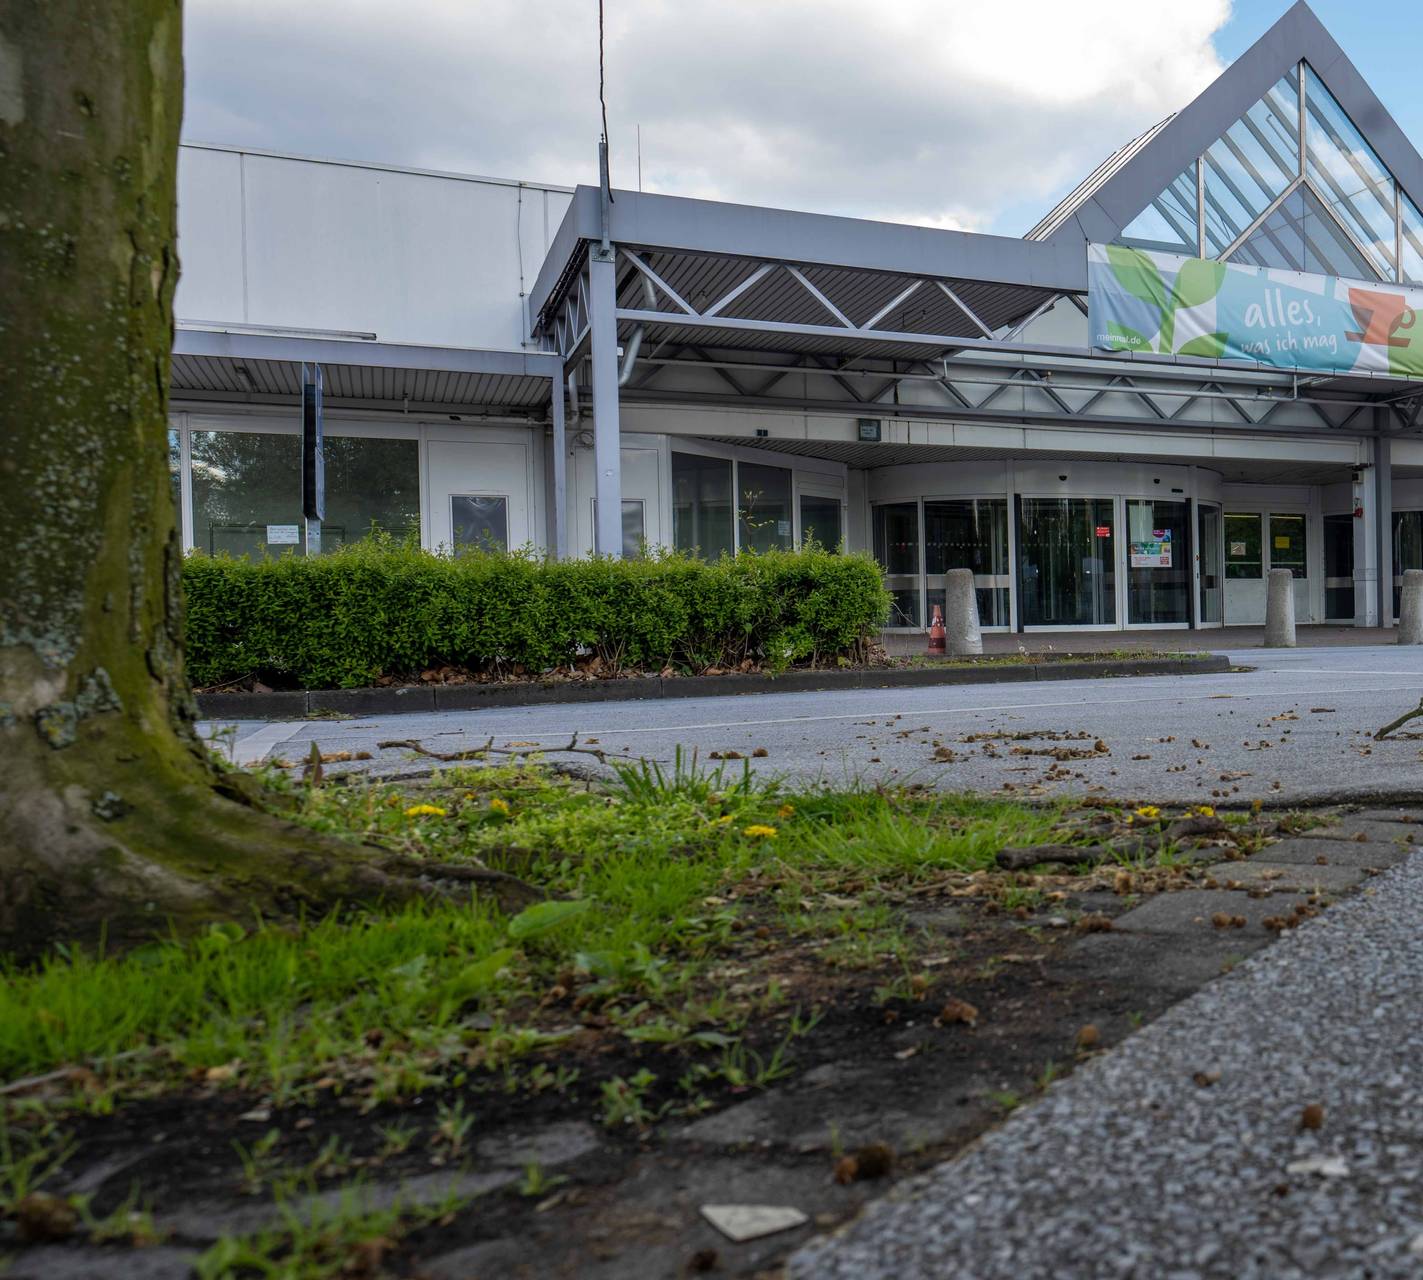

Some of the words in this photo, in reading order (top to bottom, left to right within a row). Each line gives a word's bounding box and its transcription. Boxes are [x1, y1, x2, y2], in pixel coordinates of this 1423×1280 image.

[1244, 287, 1321, 329] alles,
[1241, 338, 1271, 354] was
[1275, 330, 1298, 351] ich
[1303, 334, 1338, 354] mag
